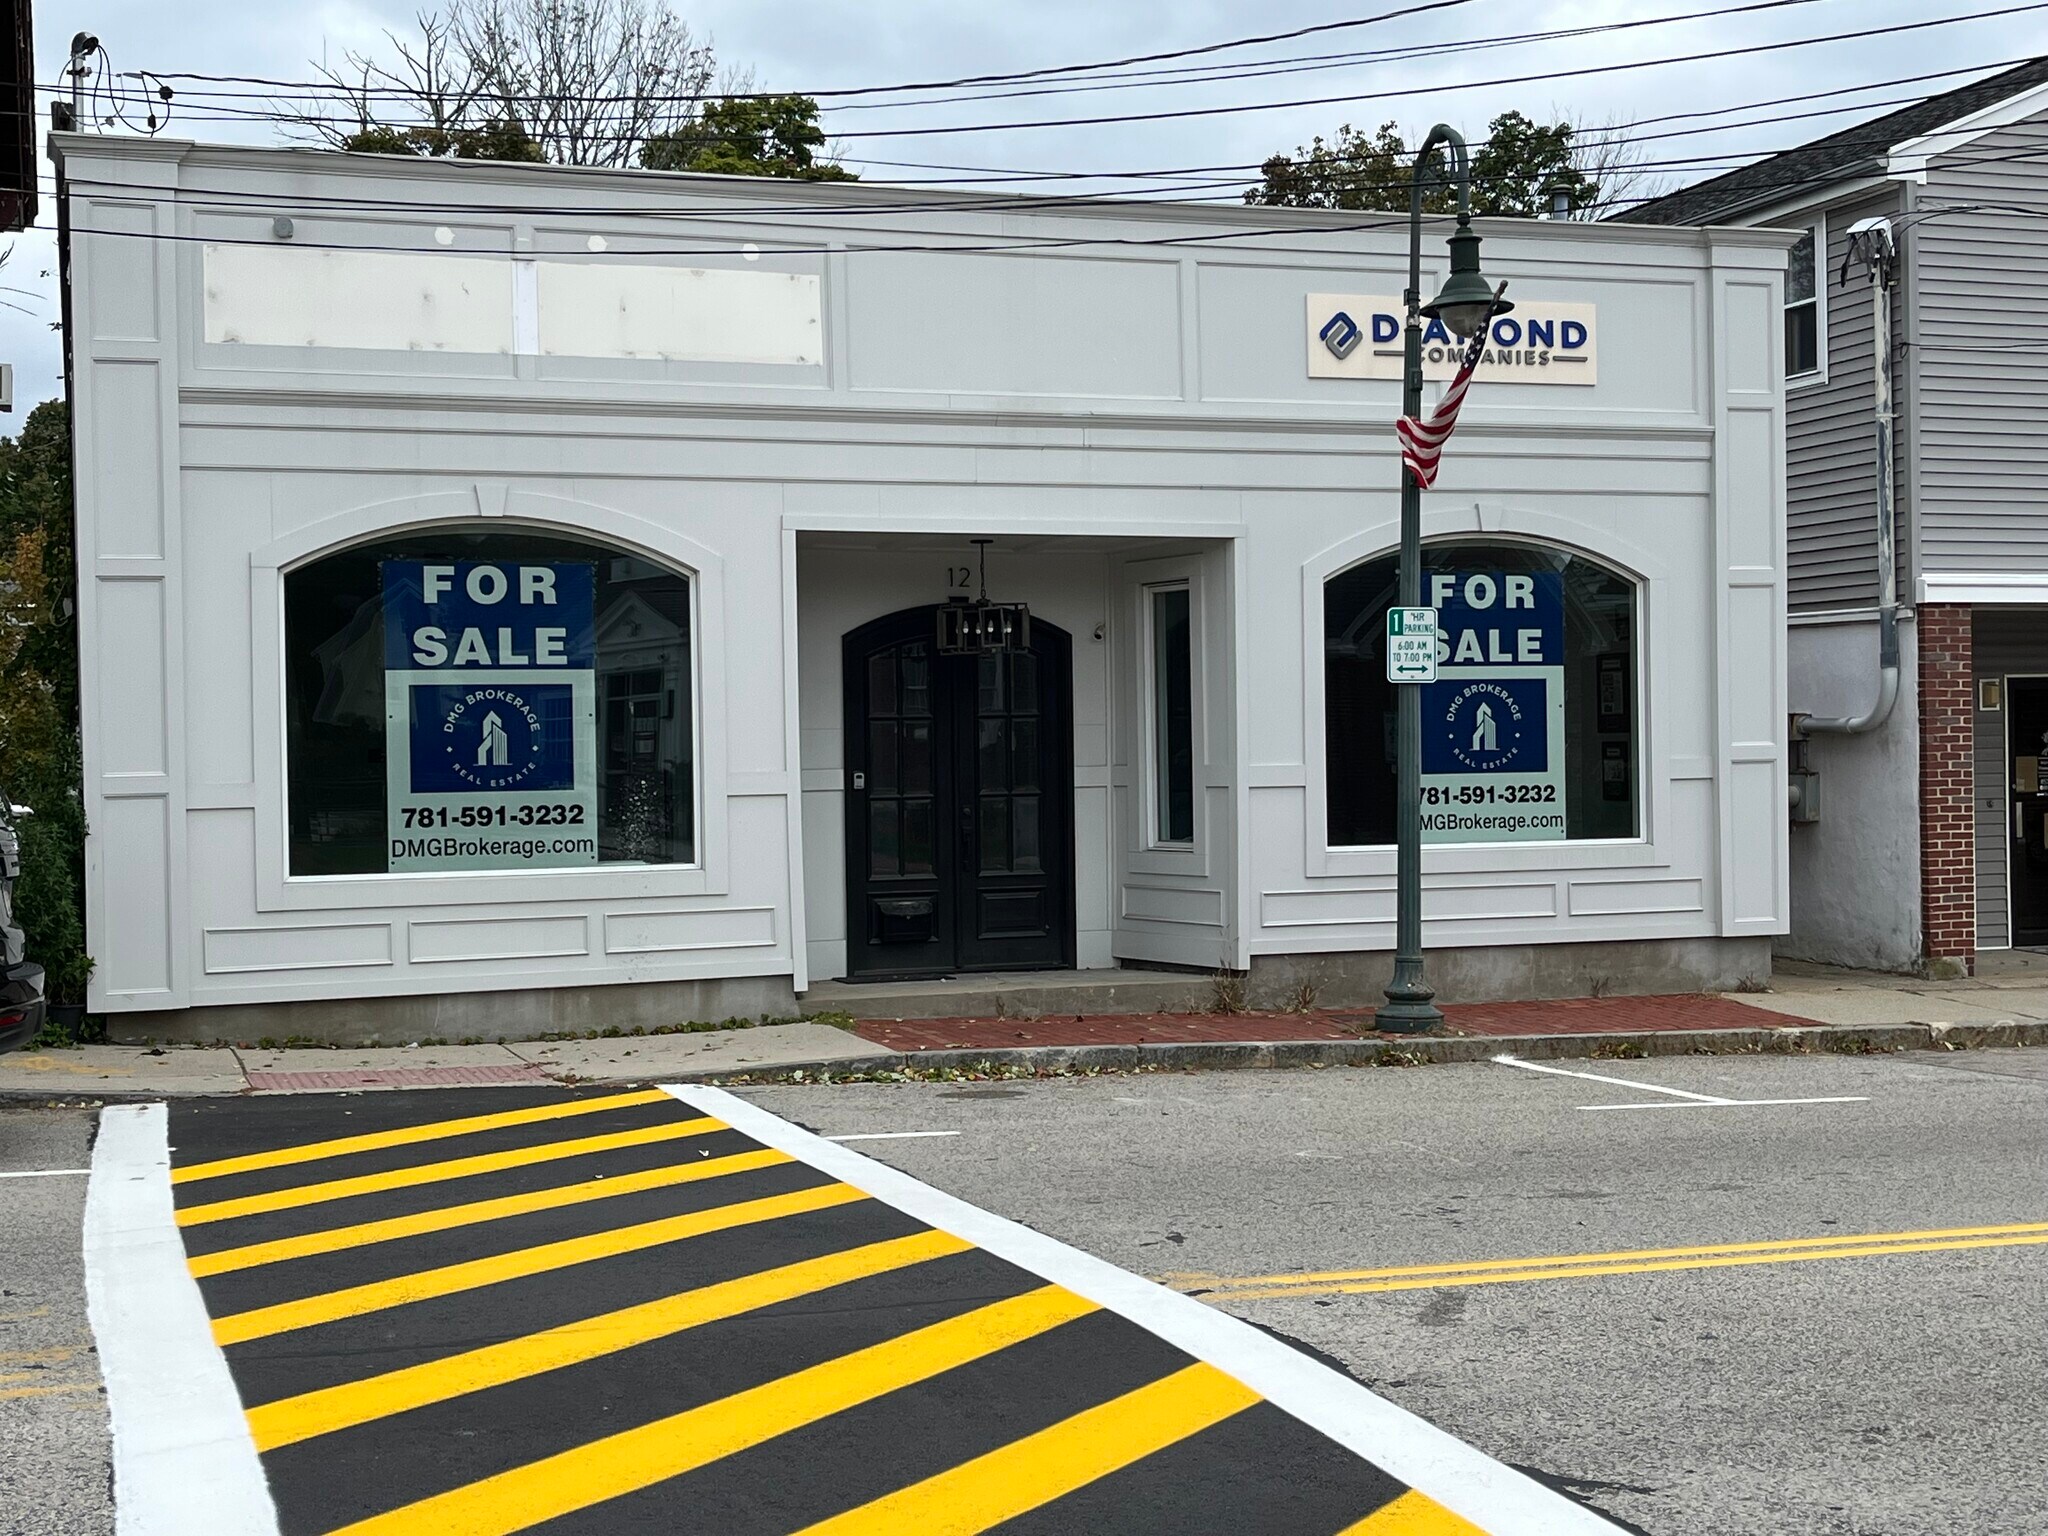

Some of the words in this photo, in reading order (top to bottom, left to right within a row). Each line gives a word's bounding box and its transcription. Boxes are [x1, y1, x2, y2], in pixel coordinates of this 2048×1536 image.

[1372, 313, 1588, 349] DAOND
[1418, 346, 1550, 366] OMANIES
[423, 565, 557, 605] FOR
[948, 567, 970, 587] 12
[1431, 574, 1535, 610] FOR
[1393, 613, 1399, 632] 1
[1404, 623, 1434, 634] PARKING
[412, 626, 568, 666] SALE
[1417, 641, 1427, 651] AM
[1393, 653, 1401, 662] TO
[1422, 653, 1432, 662] PM
[444, 703, 465, 733] DMG
[465, 689, 541, 733] BROKERAGE
[1446, 696, 1463, 722] DMG
[1463, 683, 1522, 721] BROKERAGE
[1453, 748, 1476, 768] REAL
[1482, 747, 1519, 769] ESTATE
[452, 762, 482, 786] REAL
[490, 762, 536, 787] ESTATE
[401, 804, 585, 829] 781-591-3232
[1420, 813, 1563, 832] MGBrokerage.com
[392, 837, 594, 859] DMGBrokerage.com
